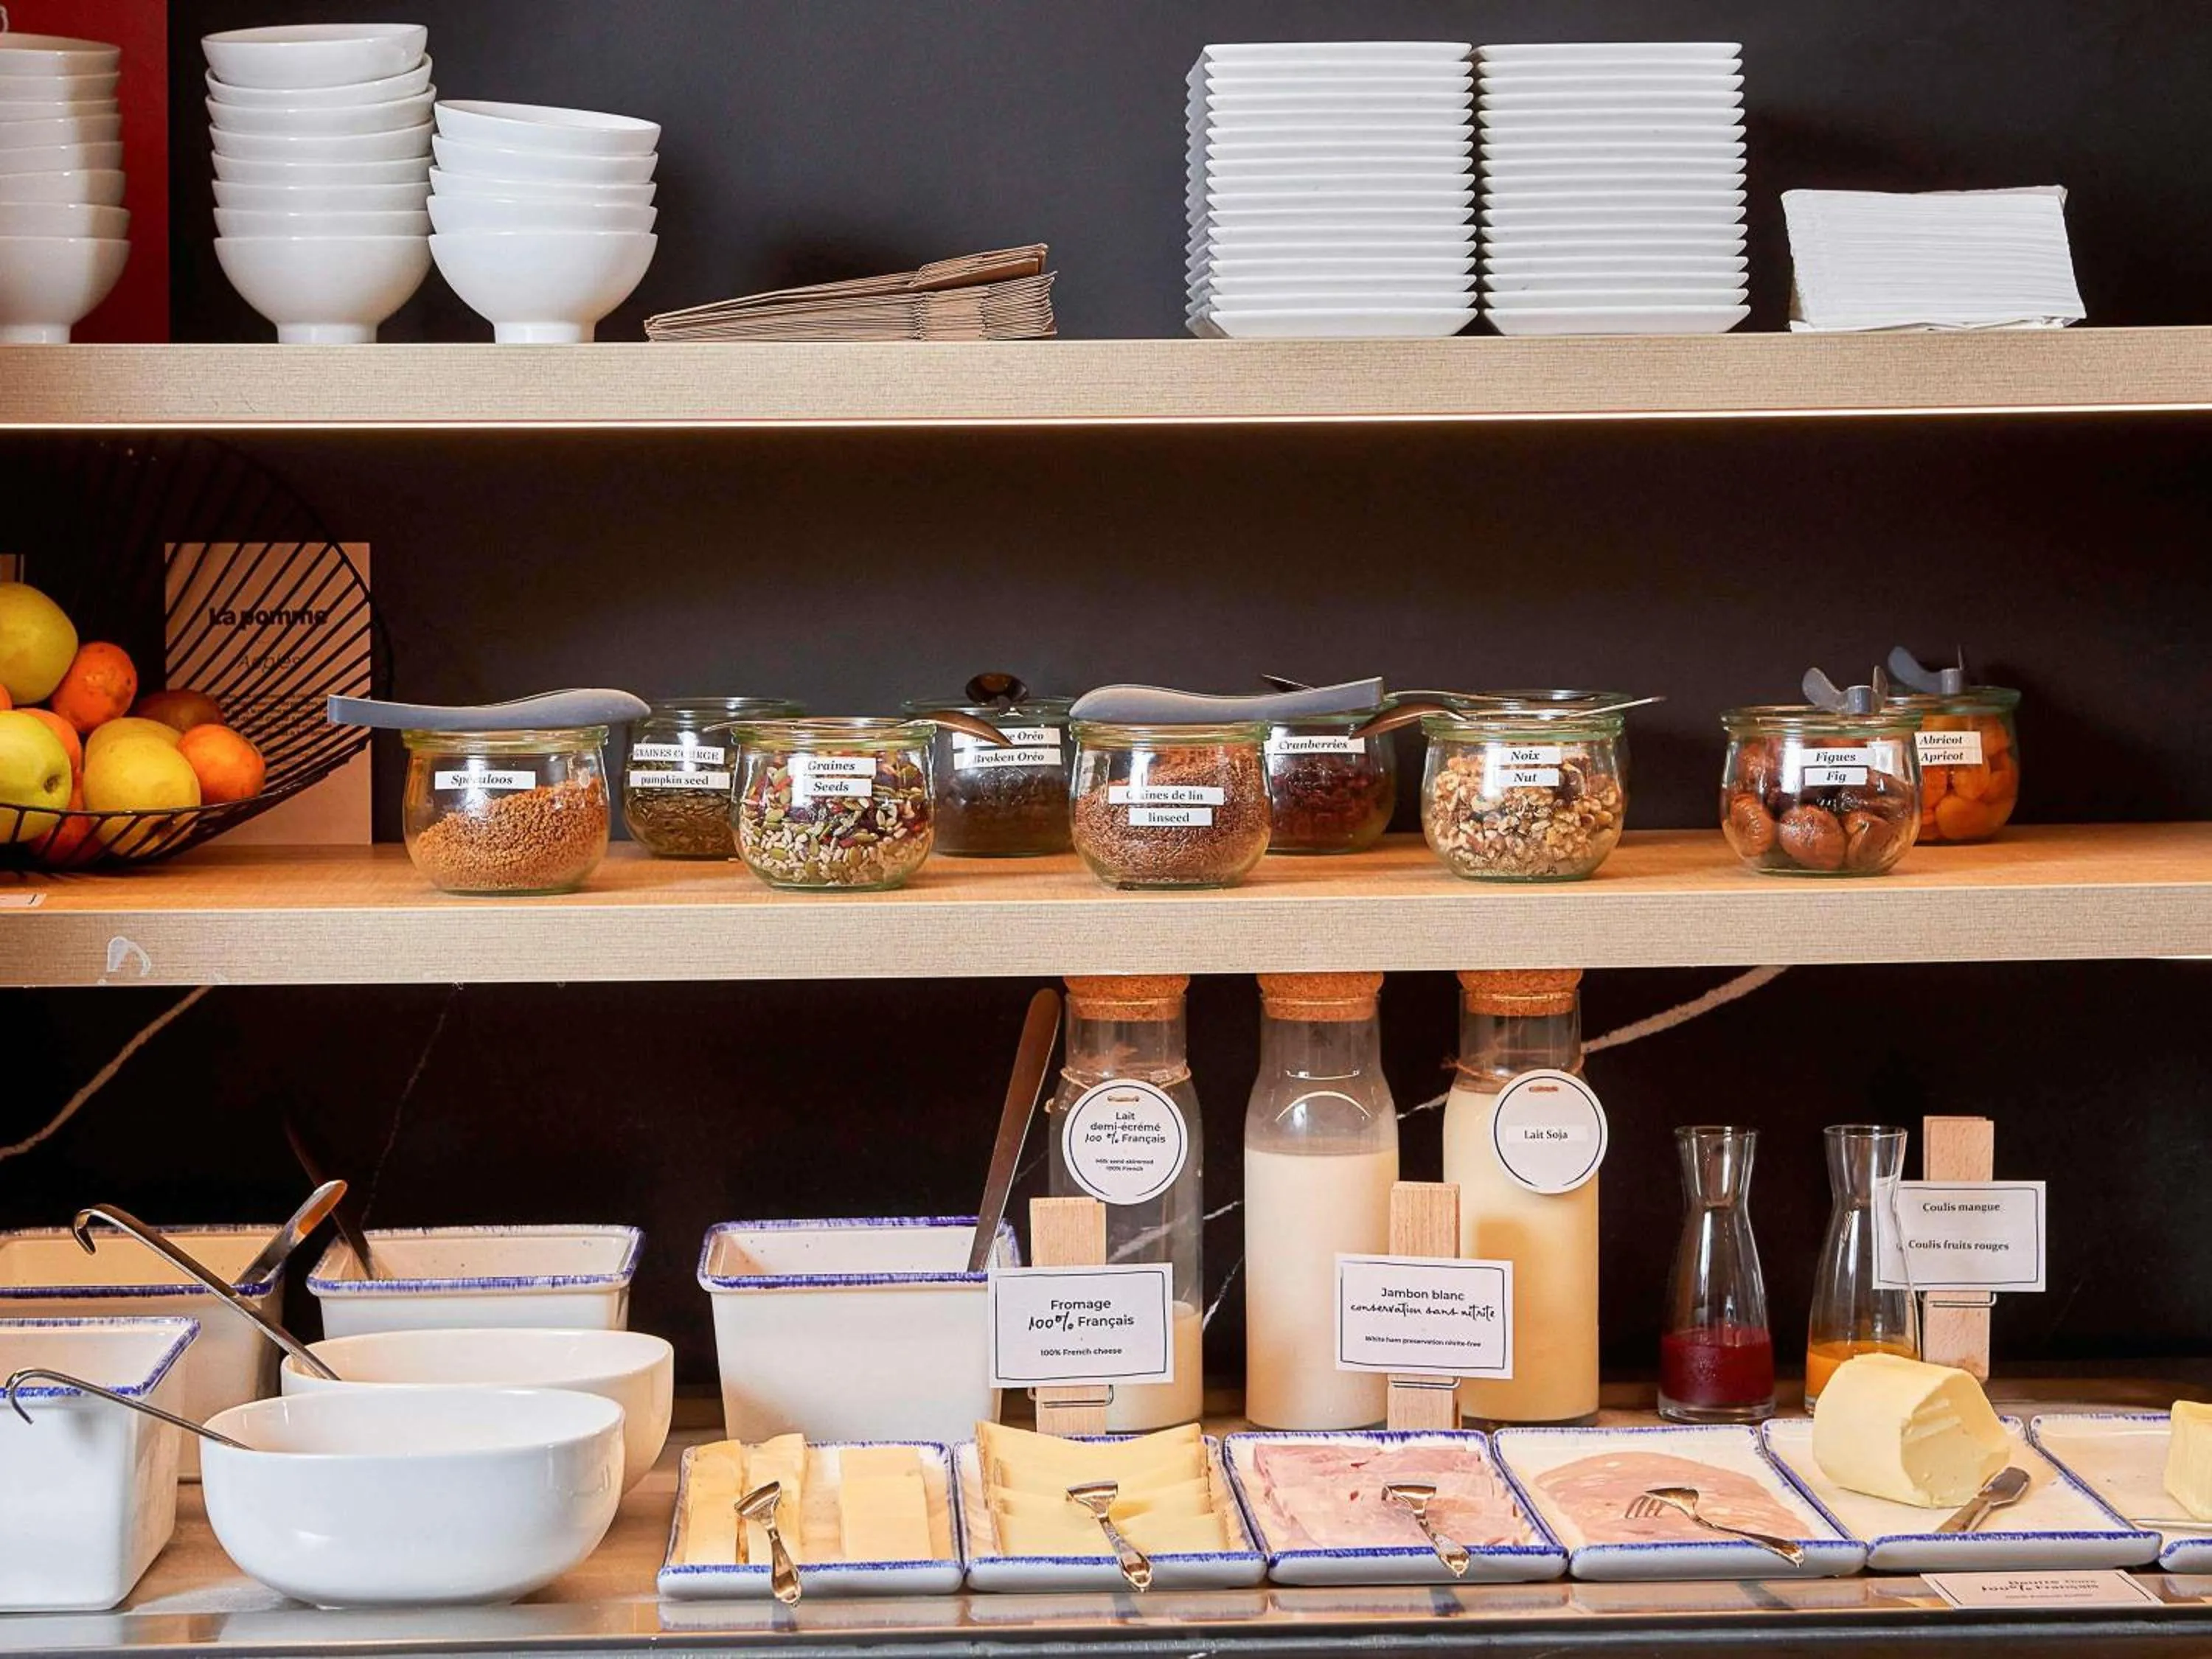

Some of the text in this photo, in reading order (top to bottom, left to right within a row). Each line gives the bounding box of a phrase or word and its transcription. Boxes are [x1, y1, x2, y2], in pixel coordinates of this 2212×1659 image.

[240, 608, 329, 630] pomme
[1017, 731, 1044, 740] Oréo
[1919, 734, 1963, 745] Abricot
[1279, 738, 1348, 751] Cranberries
[673, 749, 720, 761] CRGE
[974, 751, 1045, 763] Broken Oréo
[1511, 749, 1540, 761] Noix
[1815, 751, 1857, 764] Figues
[1921, 751, 1964, 763] Apricot
[807, 759, 856, 771] Graines
[451, 773, 514, 787] Spuloos
[640, 775, 709, 787] pumpkin seed
[1514, 772, 1537, 782] Nut
[1826, 771, 1847, 783] Fig
[813, 781, 849, 792] Seeds
[1126, 790, 1203, 800] ines de lin
[1148, 812, 1190, 823] linseed
[1116, 1111, 1135, 1121] Lait
[1090, 1121, 1161, 1132] demi-écrémé
[1121, 1133, 1166, 1144] Français
[1524, 1129, 1568, 1141] Lait Soja
[1922, 1203, 2000, 1214] Coulis mangue
[1908, 1239, 2009, 1252] Coulis fruits rouges
[1380, 1287, 1466, 1301] Jambon blanc
[1051, 1299, 1112, 1312] Fromage
[1350, 1302, 1495, 1321] conservation sans nitrite
[1029, 1311, 1135, 1332] 100% Français
[1402, 1338, 1444, 1346] preservation
[1040, 1347, 1122, 1357] 100% French cheese
